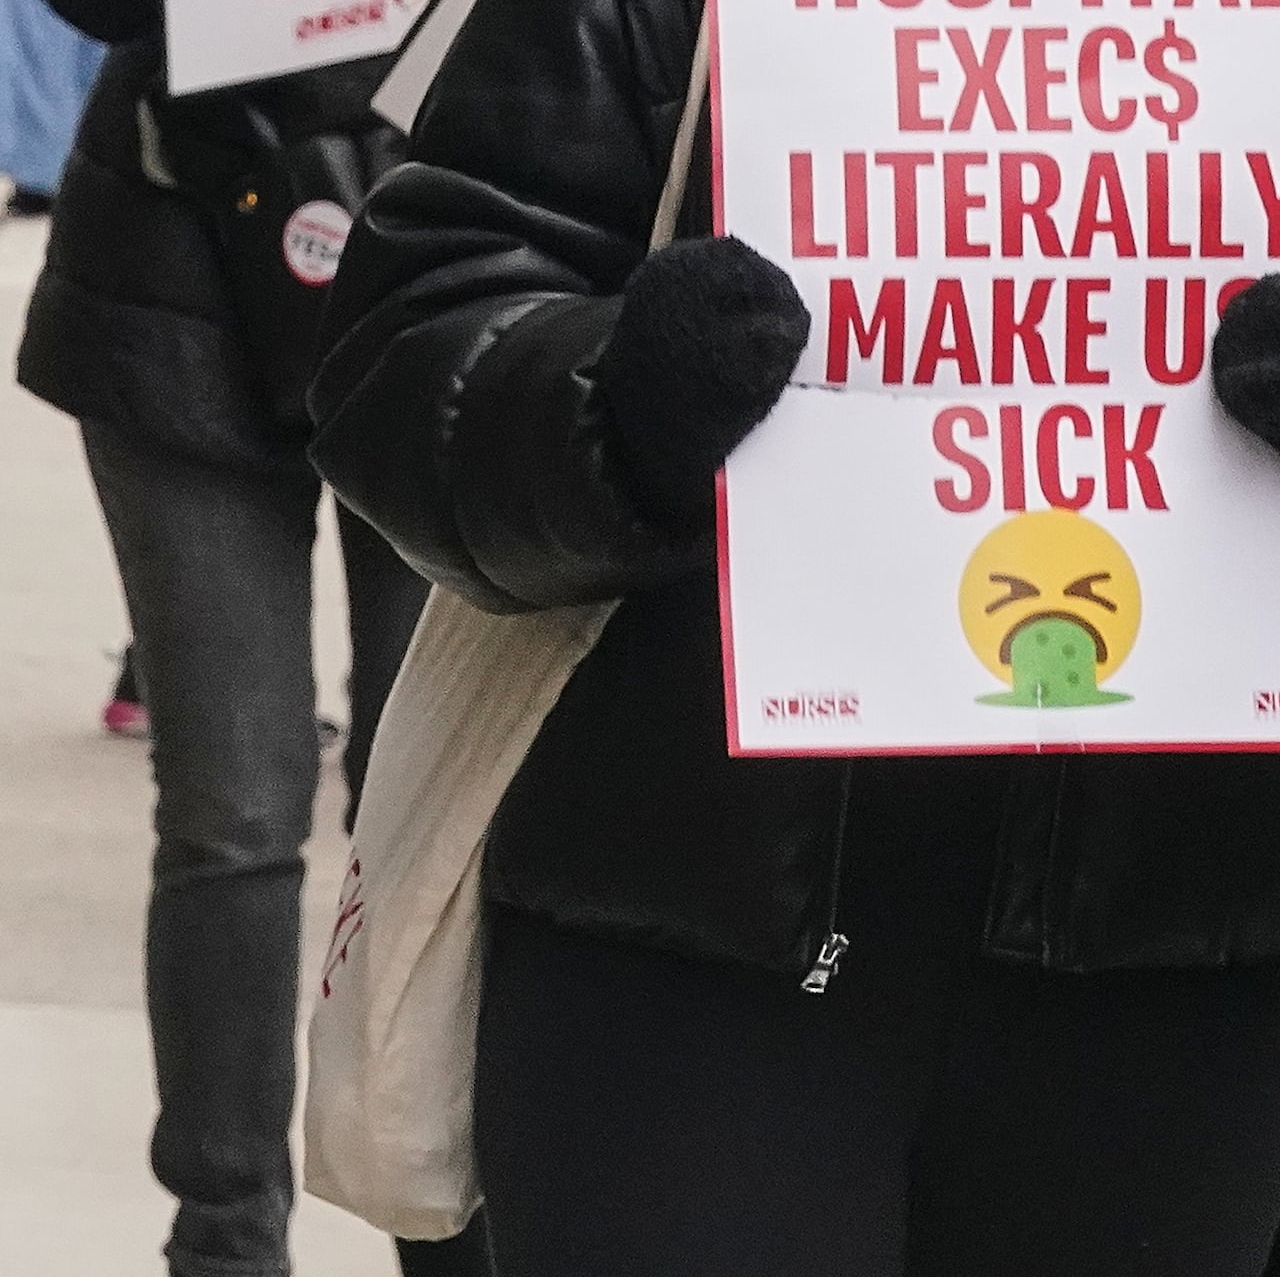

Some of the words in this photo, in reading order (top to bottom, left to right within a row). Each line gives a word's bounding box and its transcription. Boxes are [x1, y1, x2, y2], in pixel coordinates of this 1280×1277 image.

[894, 19, 1199, 142] EXEC$
[824, 277, 1108, 386] MAKE
[932, 403, 1171, 512] SICK
